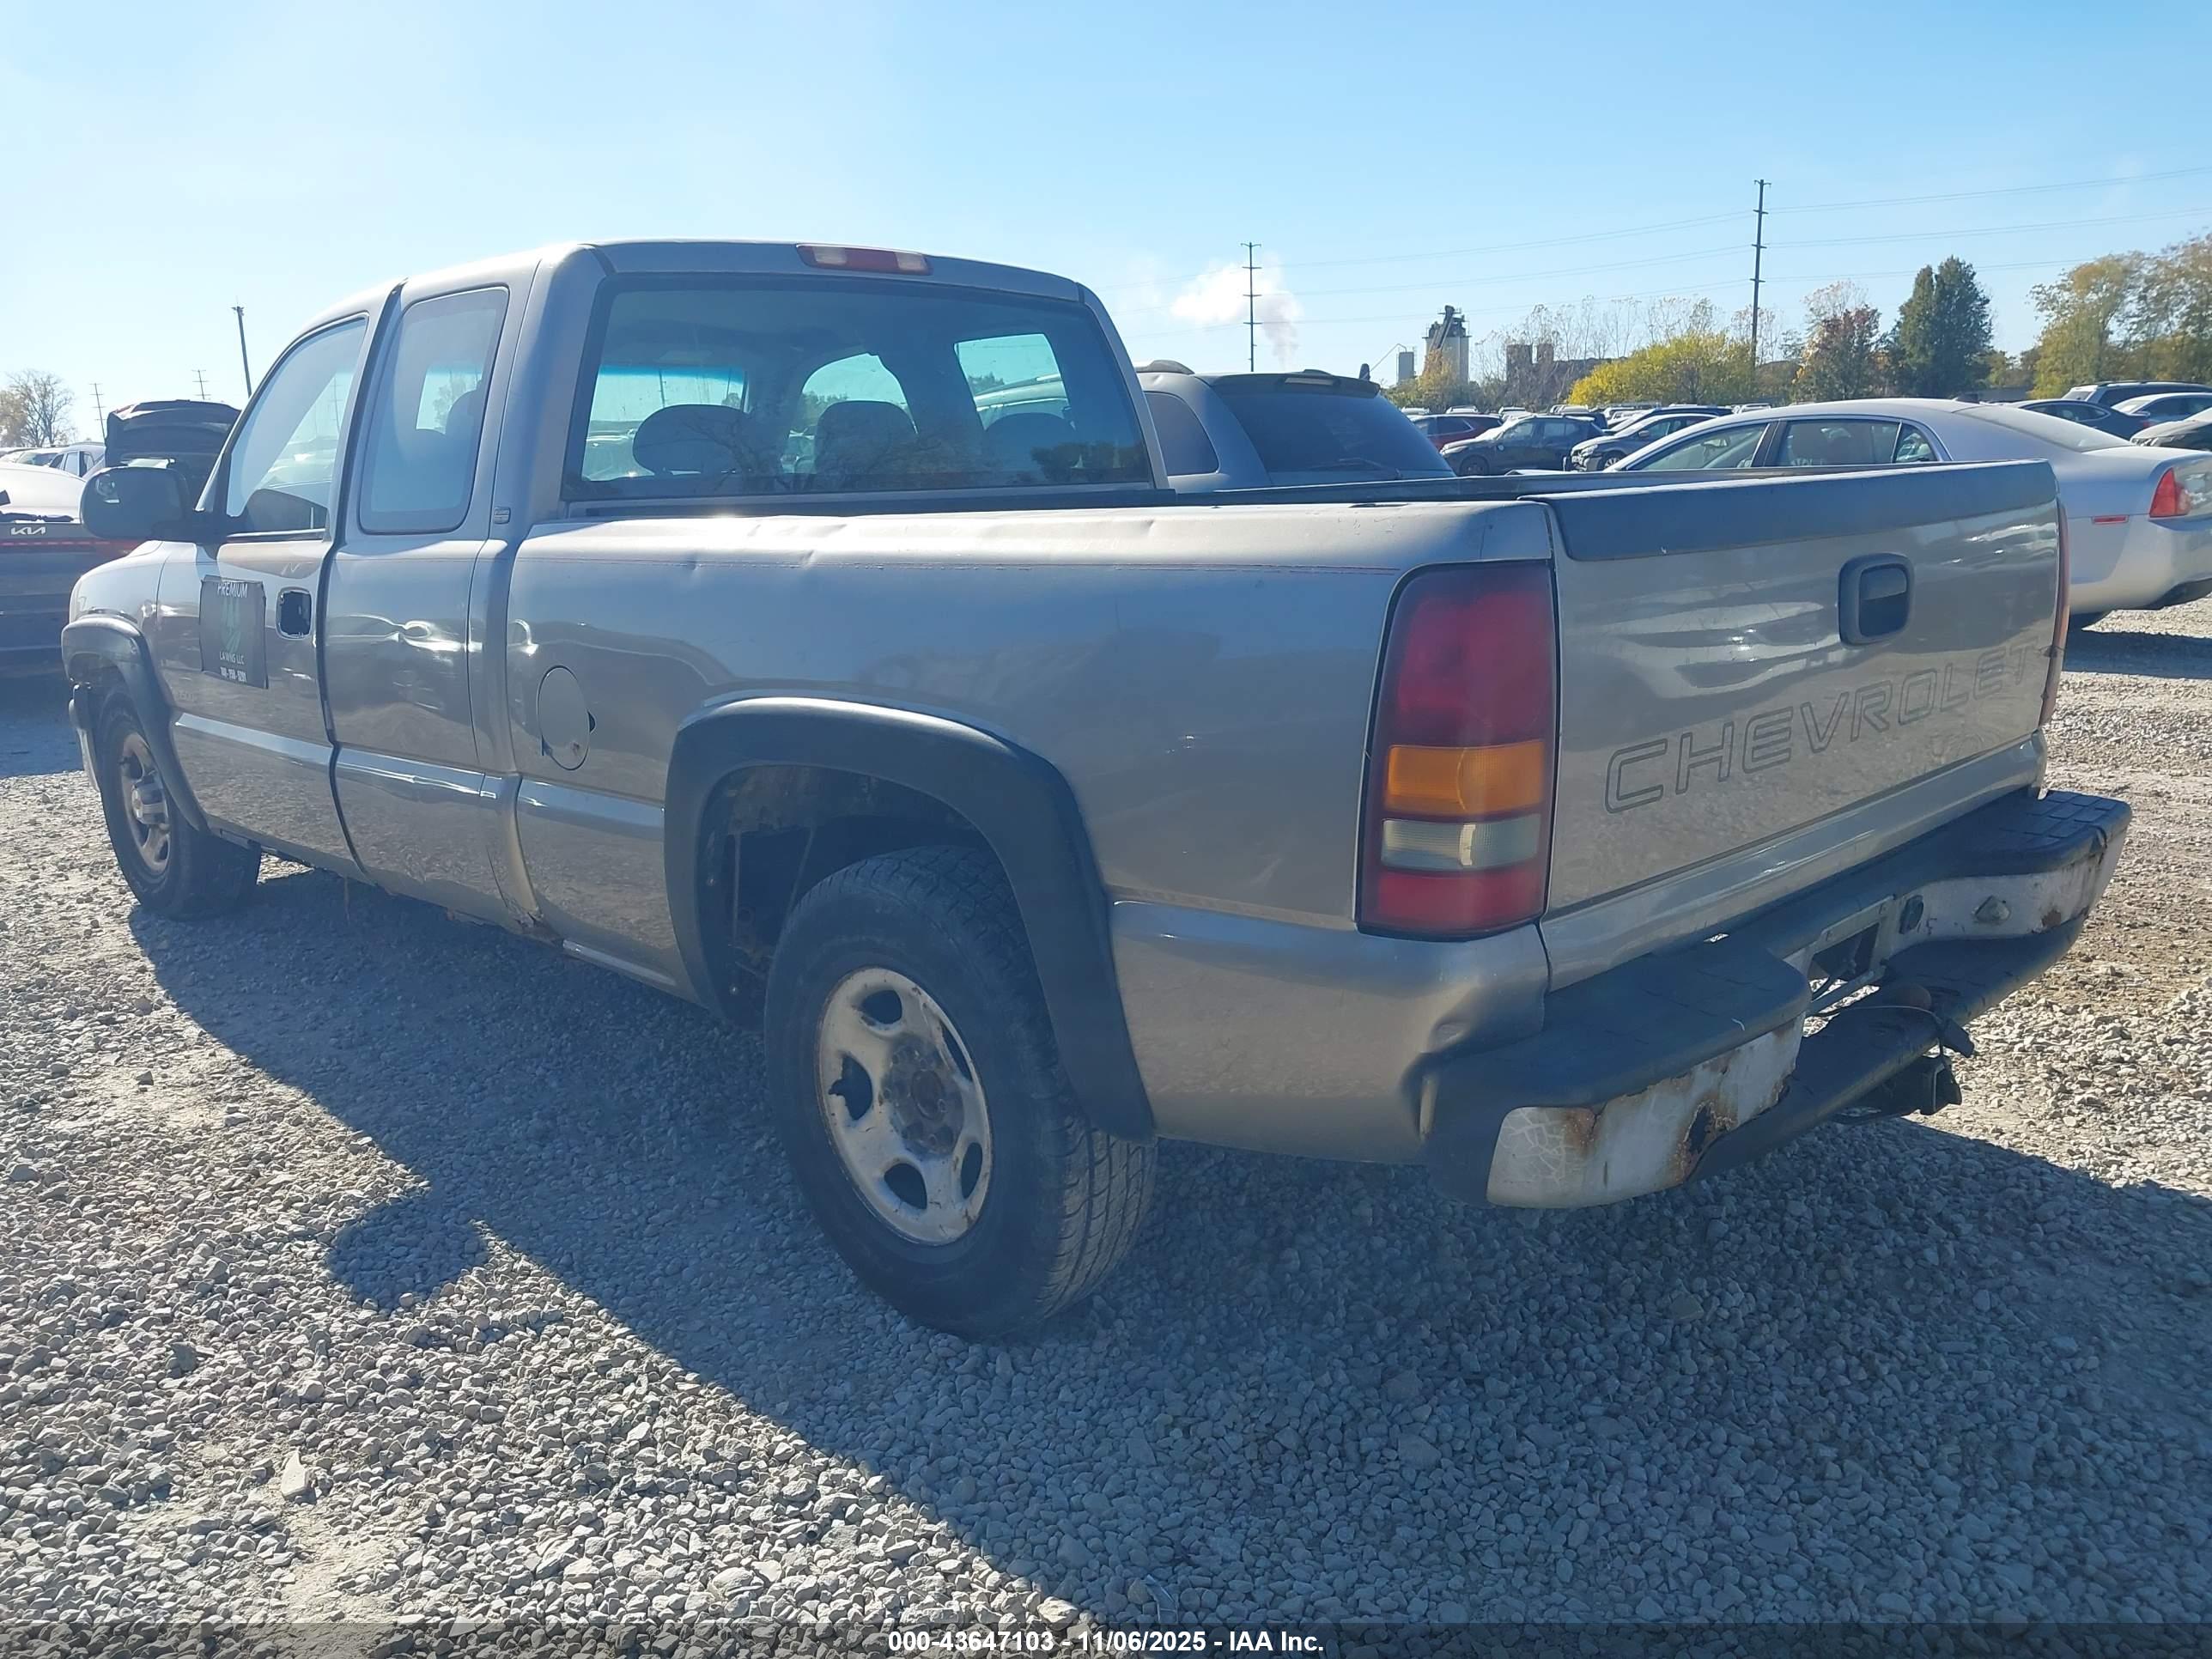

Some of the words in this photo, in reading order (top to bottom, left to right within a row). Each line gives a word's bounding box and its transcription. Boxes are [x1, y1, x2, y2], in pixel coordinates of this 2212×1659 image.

[11, 526, 46, 535] KIA
[218, 582, 248, 599] PREMIUM
[1606, 639, 2041, 813] CHEVROLET
